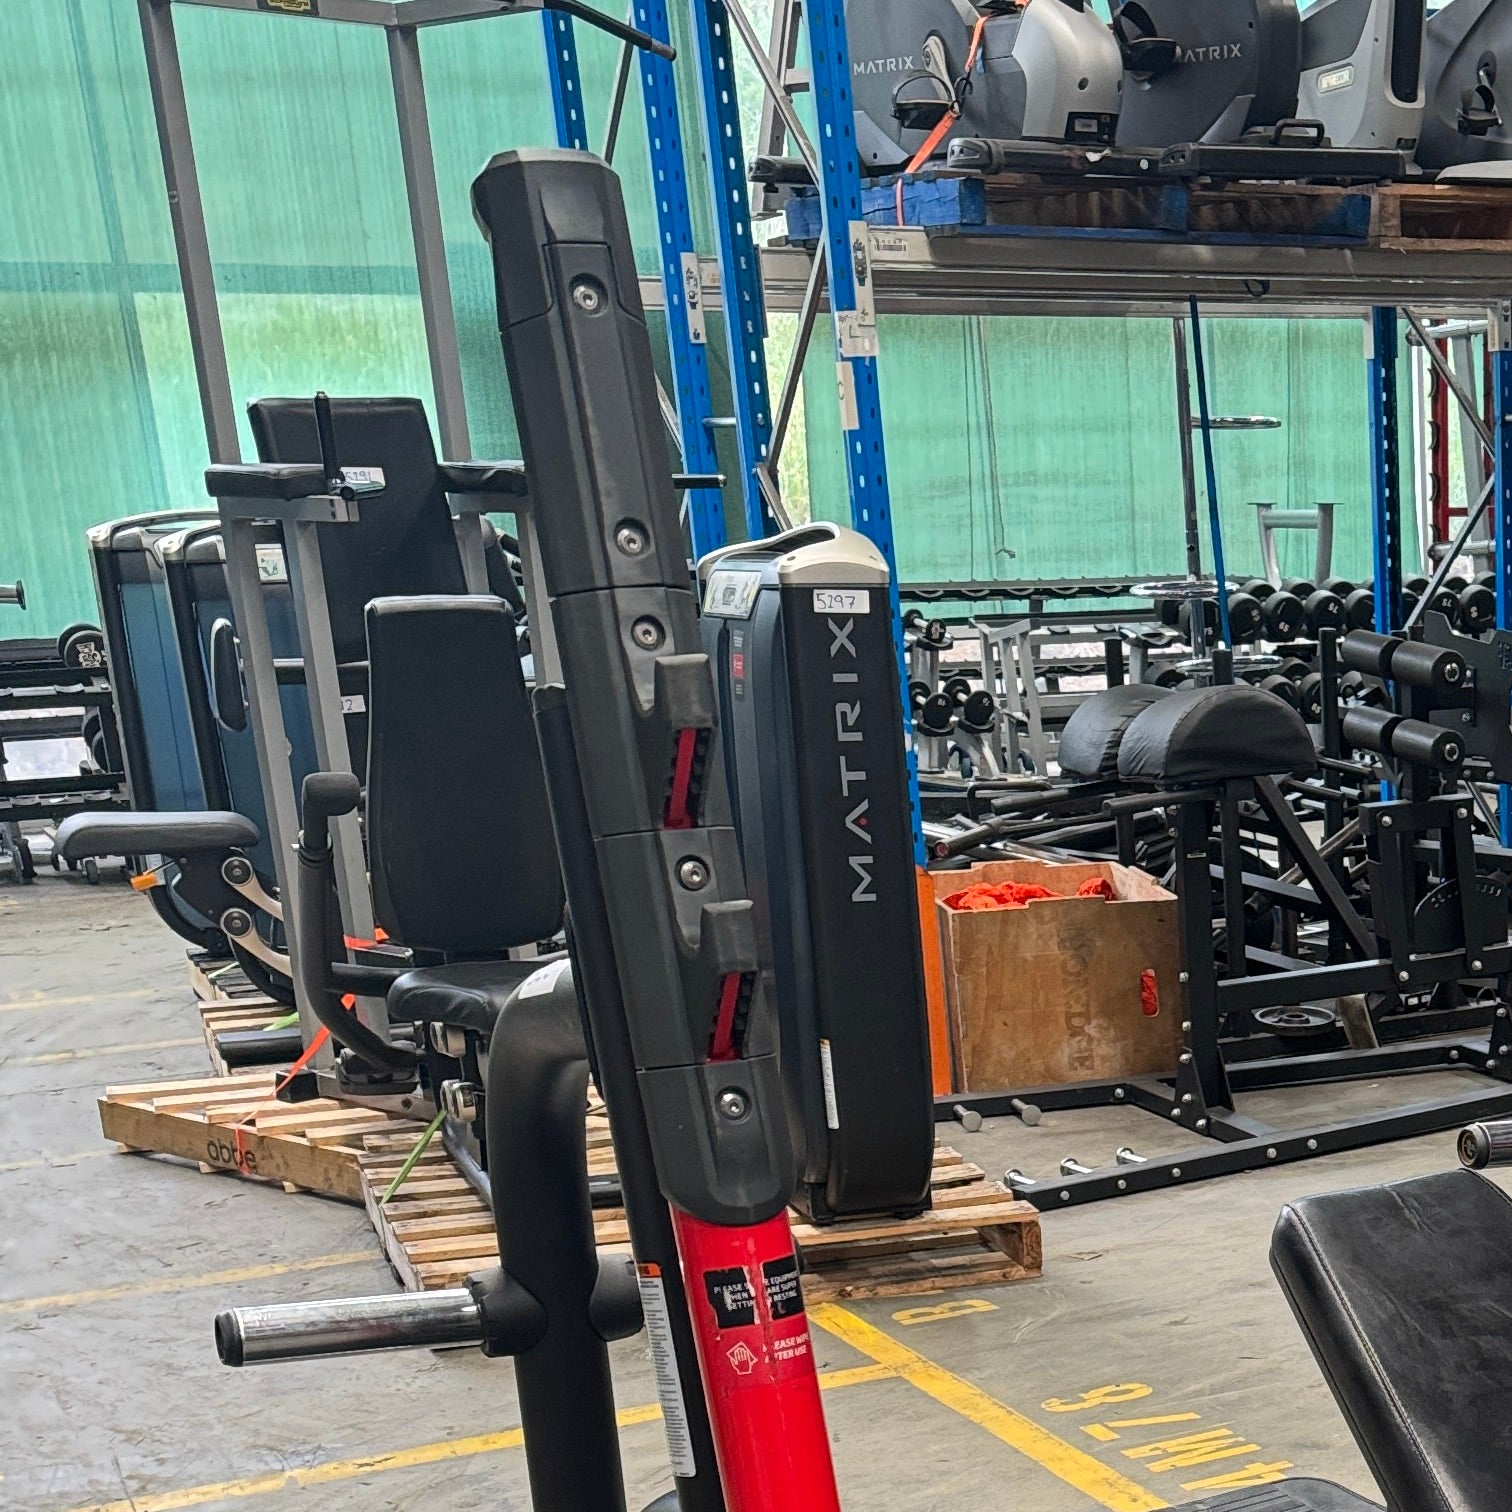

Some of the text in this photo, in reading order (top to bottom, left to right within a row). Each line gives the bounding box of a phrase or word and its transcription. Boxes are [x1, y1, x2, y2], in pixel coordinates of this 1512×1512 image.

[1182, 43, 1242, 64] ATRIX
[854, 56, 914, 76] MATRIX
[828, 617, 877, 903] MATRIX
